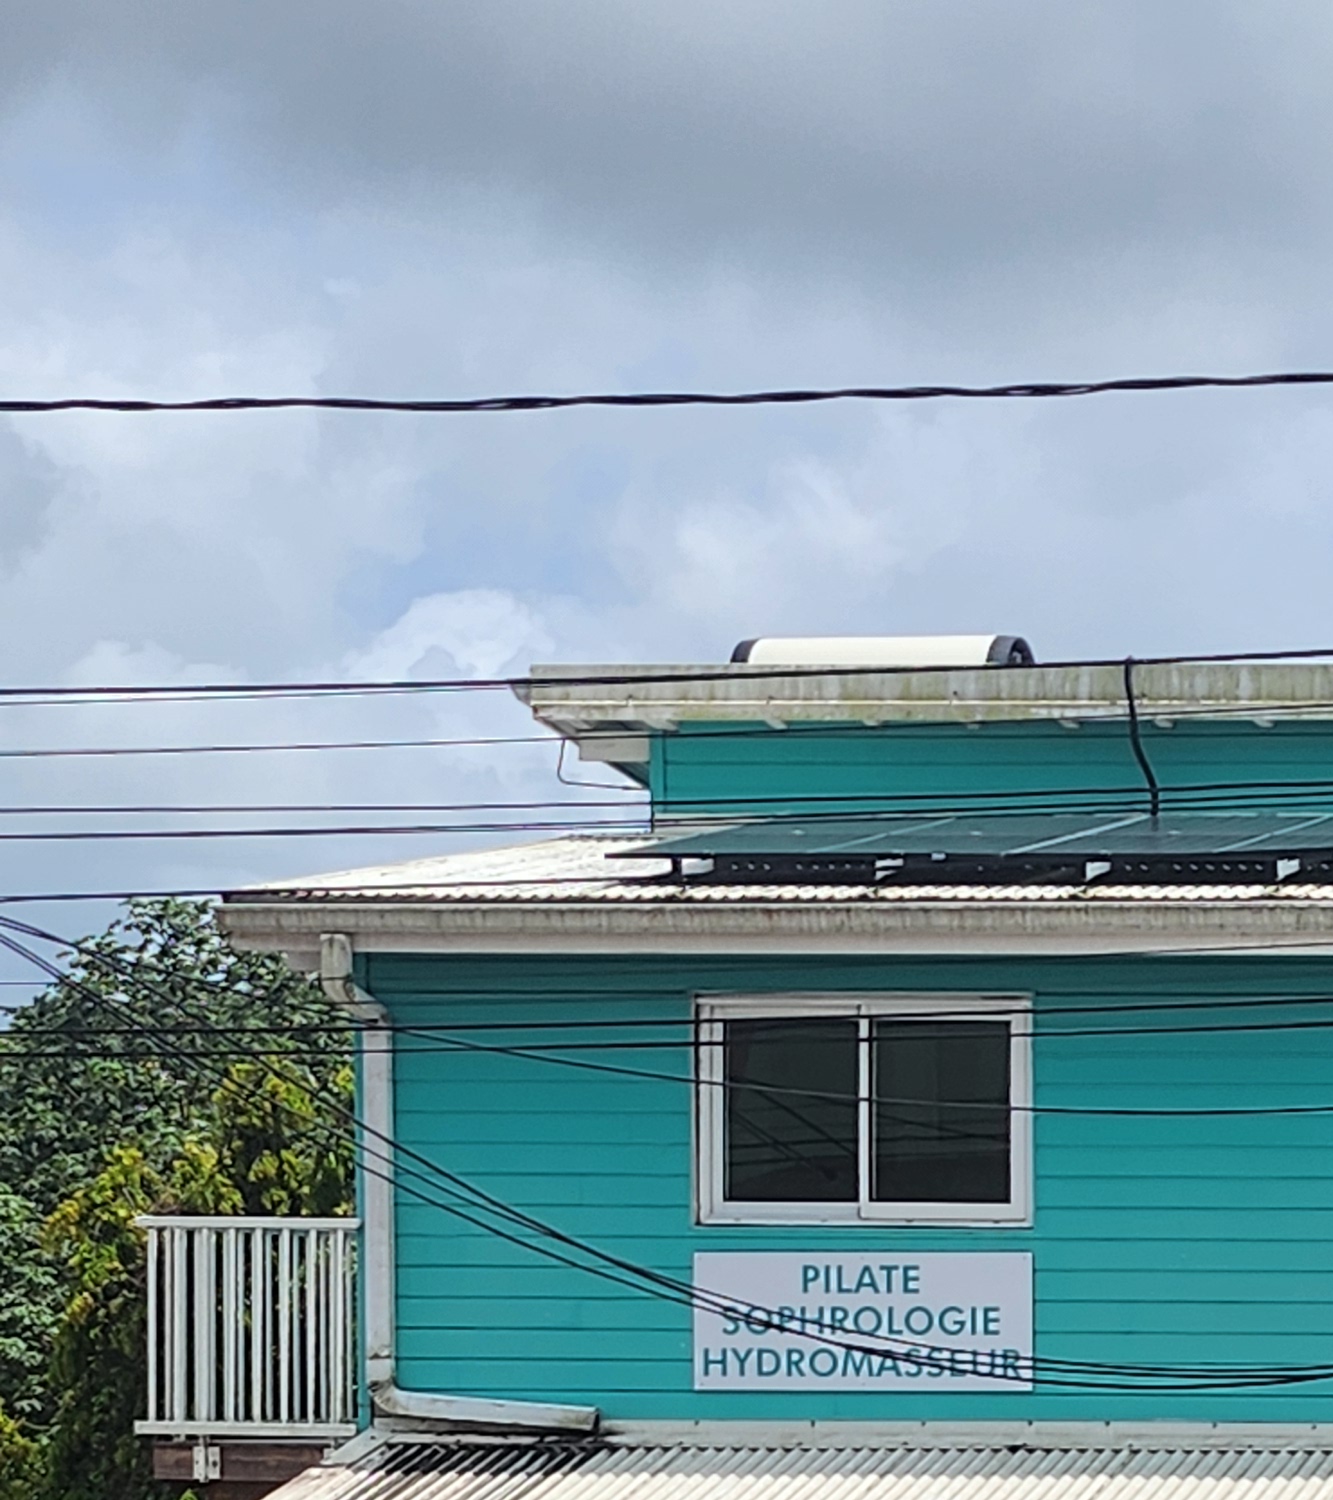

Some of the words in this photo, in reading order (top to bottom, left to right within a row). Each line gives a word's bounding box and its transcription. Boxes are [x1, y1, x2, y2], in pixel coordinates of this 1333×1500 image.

[801, 1265, 920, 1294] PILATE
[721, 1305, 1001, 1336] SOPHROLOGIE
[702, 1347, 1022, 1378] HYDROMASSEUR
